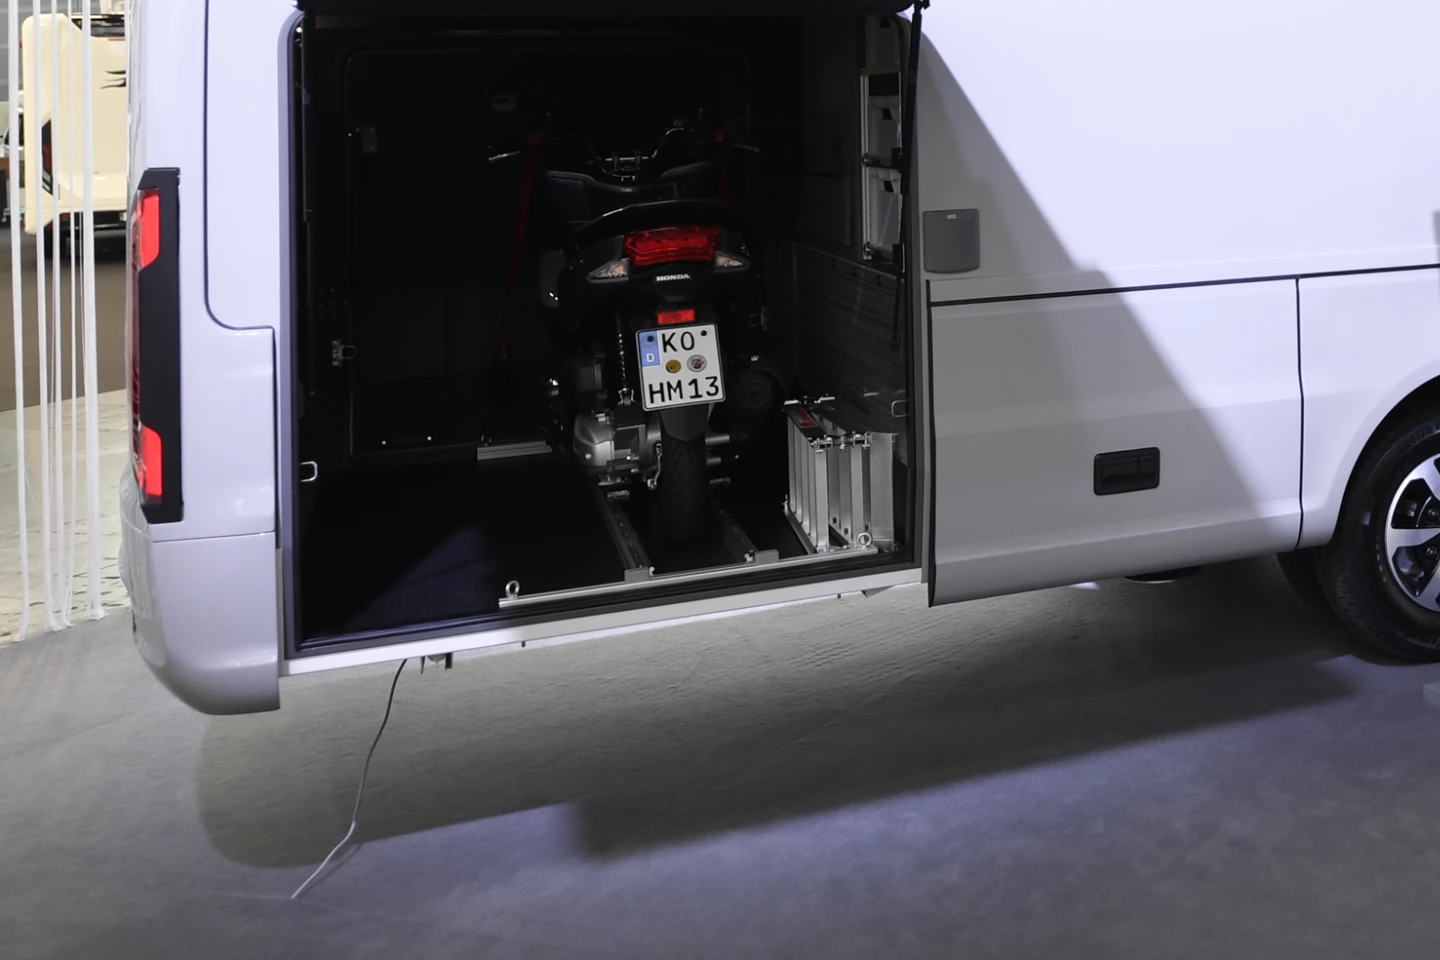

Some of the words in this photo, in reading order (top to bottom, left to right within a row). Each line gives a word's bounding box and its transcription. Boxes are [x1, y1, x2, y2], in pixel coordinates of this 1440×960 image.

[656, 273, 690, 282] HONDA
[661, 331, 695, 353] KO
[646, 353, 655, 362] D
